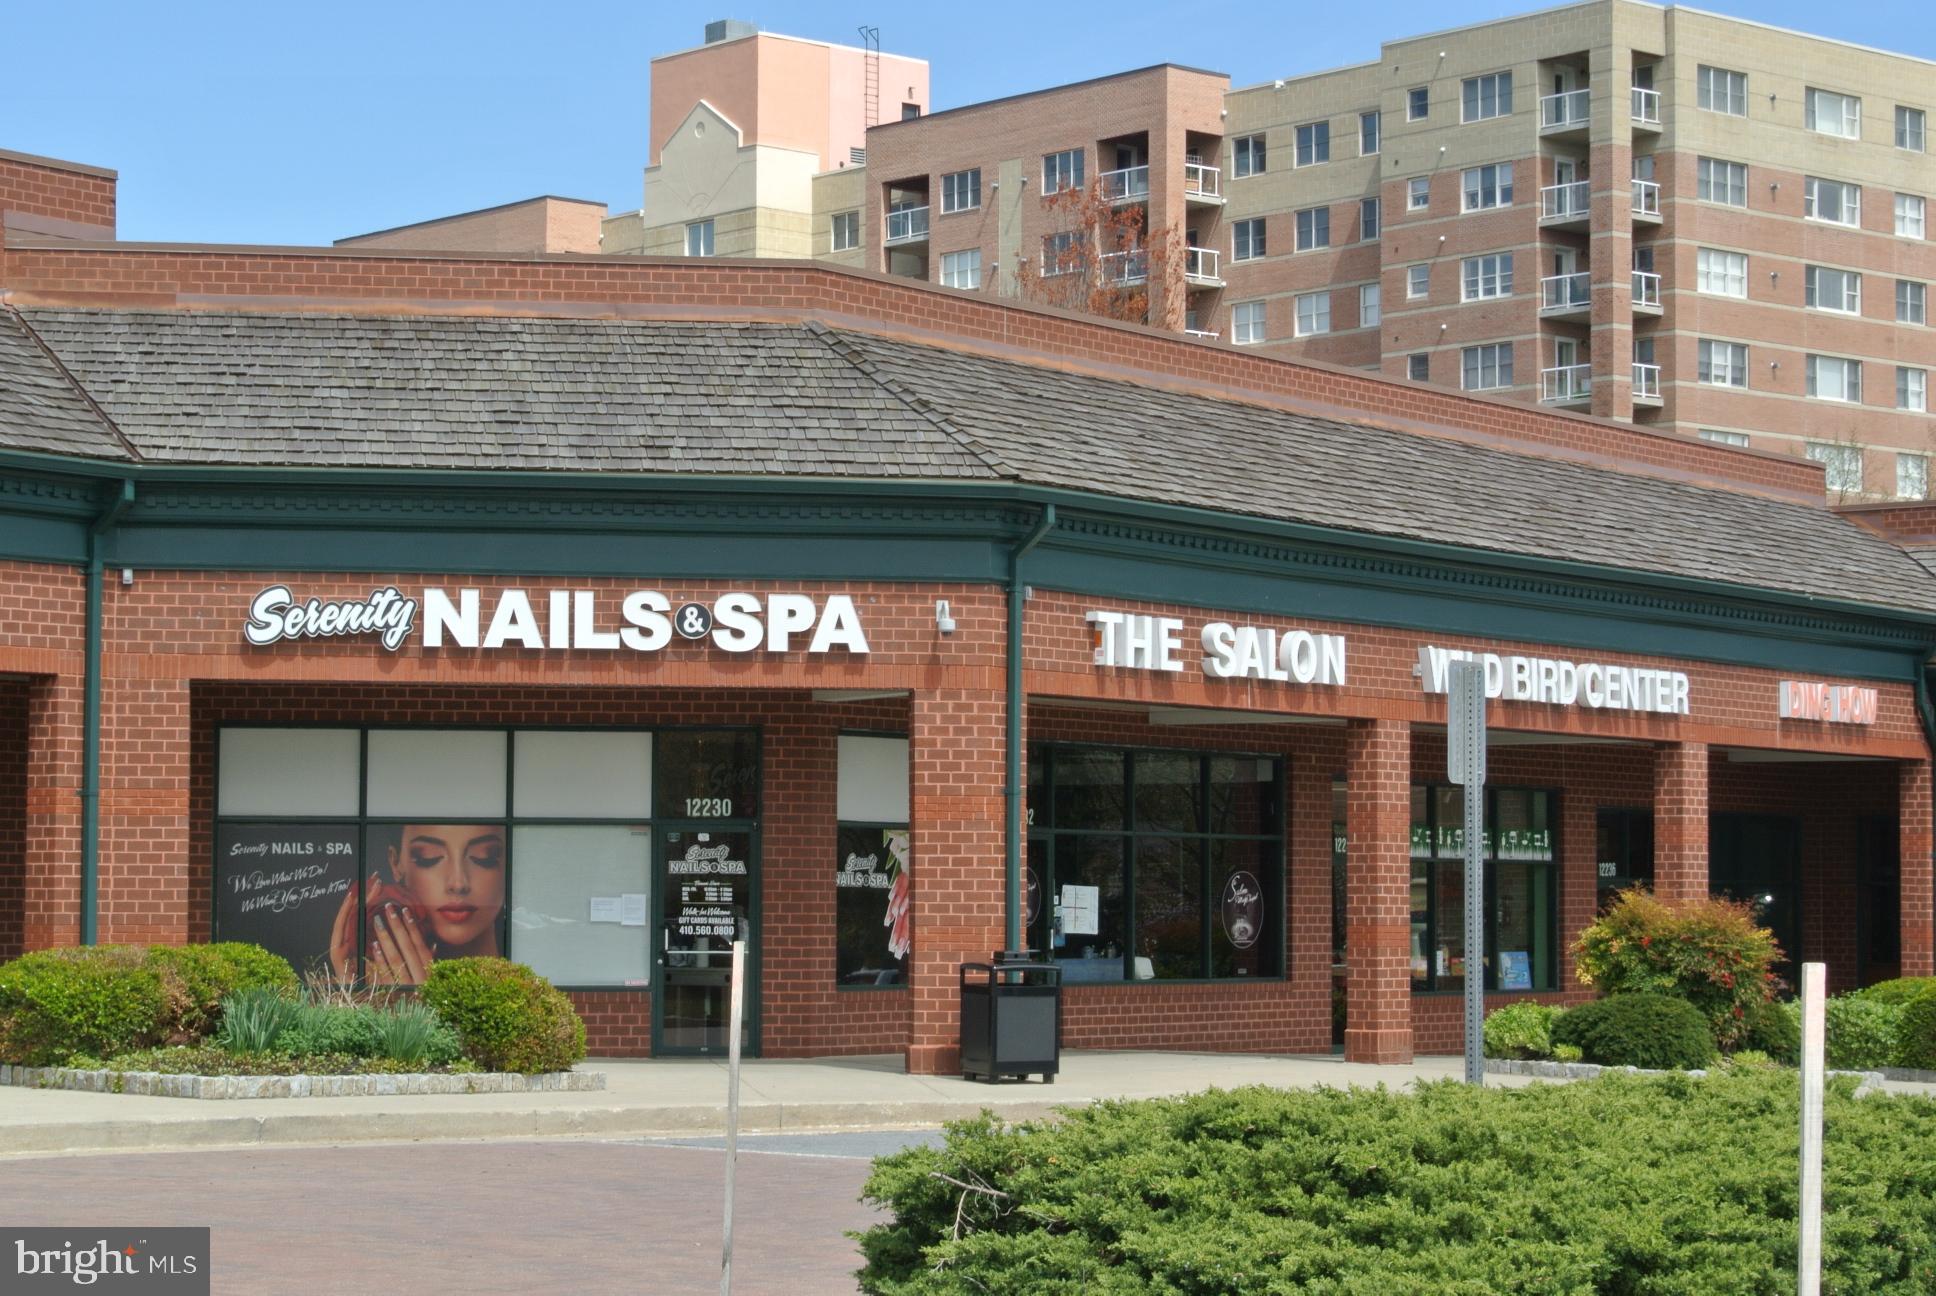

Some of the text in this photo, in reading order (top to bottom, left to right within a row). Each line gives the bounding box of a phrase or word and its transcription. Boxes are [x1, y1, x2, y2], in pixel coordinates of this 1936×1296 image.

[245, 585, 870, 653] Serenity NAILS & SPA
[1087, 611, 1346, 686] THE SALON
[1418, 645, 1690, 715] WD BIRD CENTER
[686, 798, 732, 817] 12230
[271, 842, 314, 855] NAILS
[326, 842, 353, 855] SPA
[1334, 837, 1347, 853] 122
[668, 861, 710, 875] NAILS
[719, 861, 747, 875] SPA
[870, 873, 890, 888] SPA
